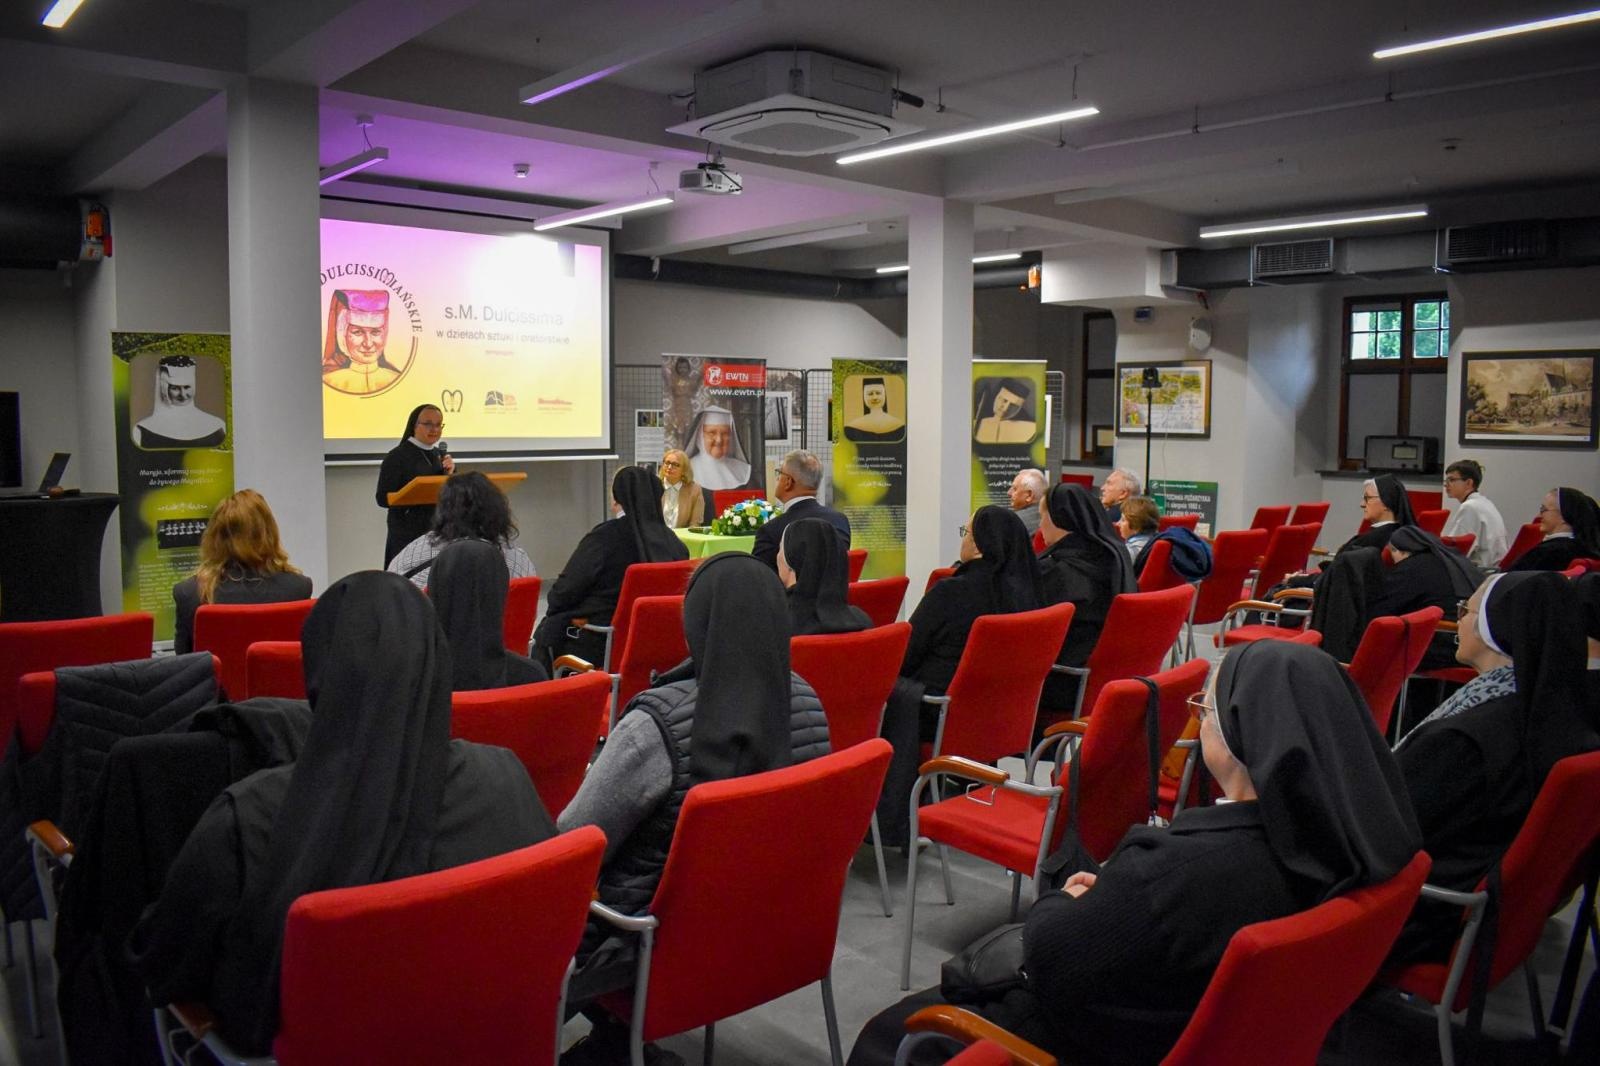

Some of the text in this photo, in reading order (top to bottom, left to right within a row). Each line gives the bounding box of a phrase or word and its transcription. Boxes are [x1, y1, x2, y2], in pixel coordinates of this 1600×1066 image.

[444, 304, 564, 326] s.M. Dulcissima
[436, 330, 444, 338] w
[446, 328, 485, 340] dziełach
[725, 372, 749, 382] EWTN
[709, 388, 765, 398] www.ewtn.pl
